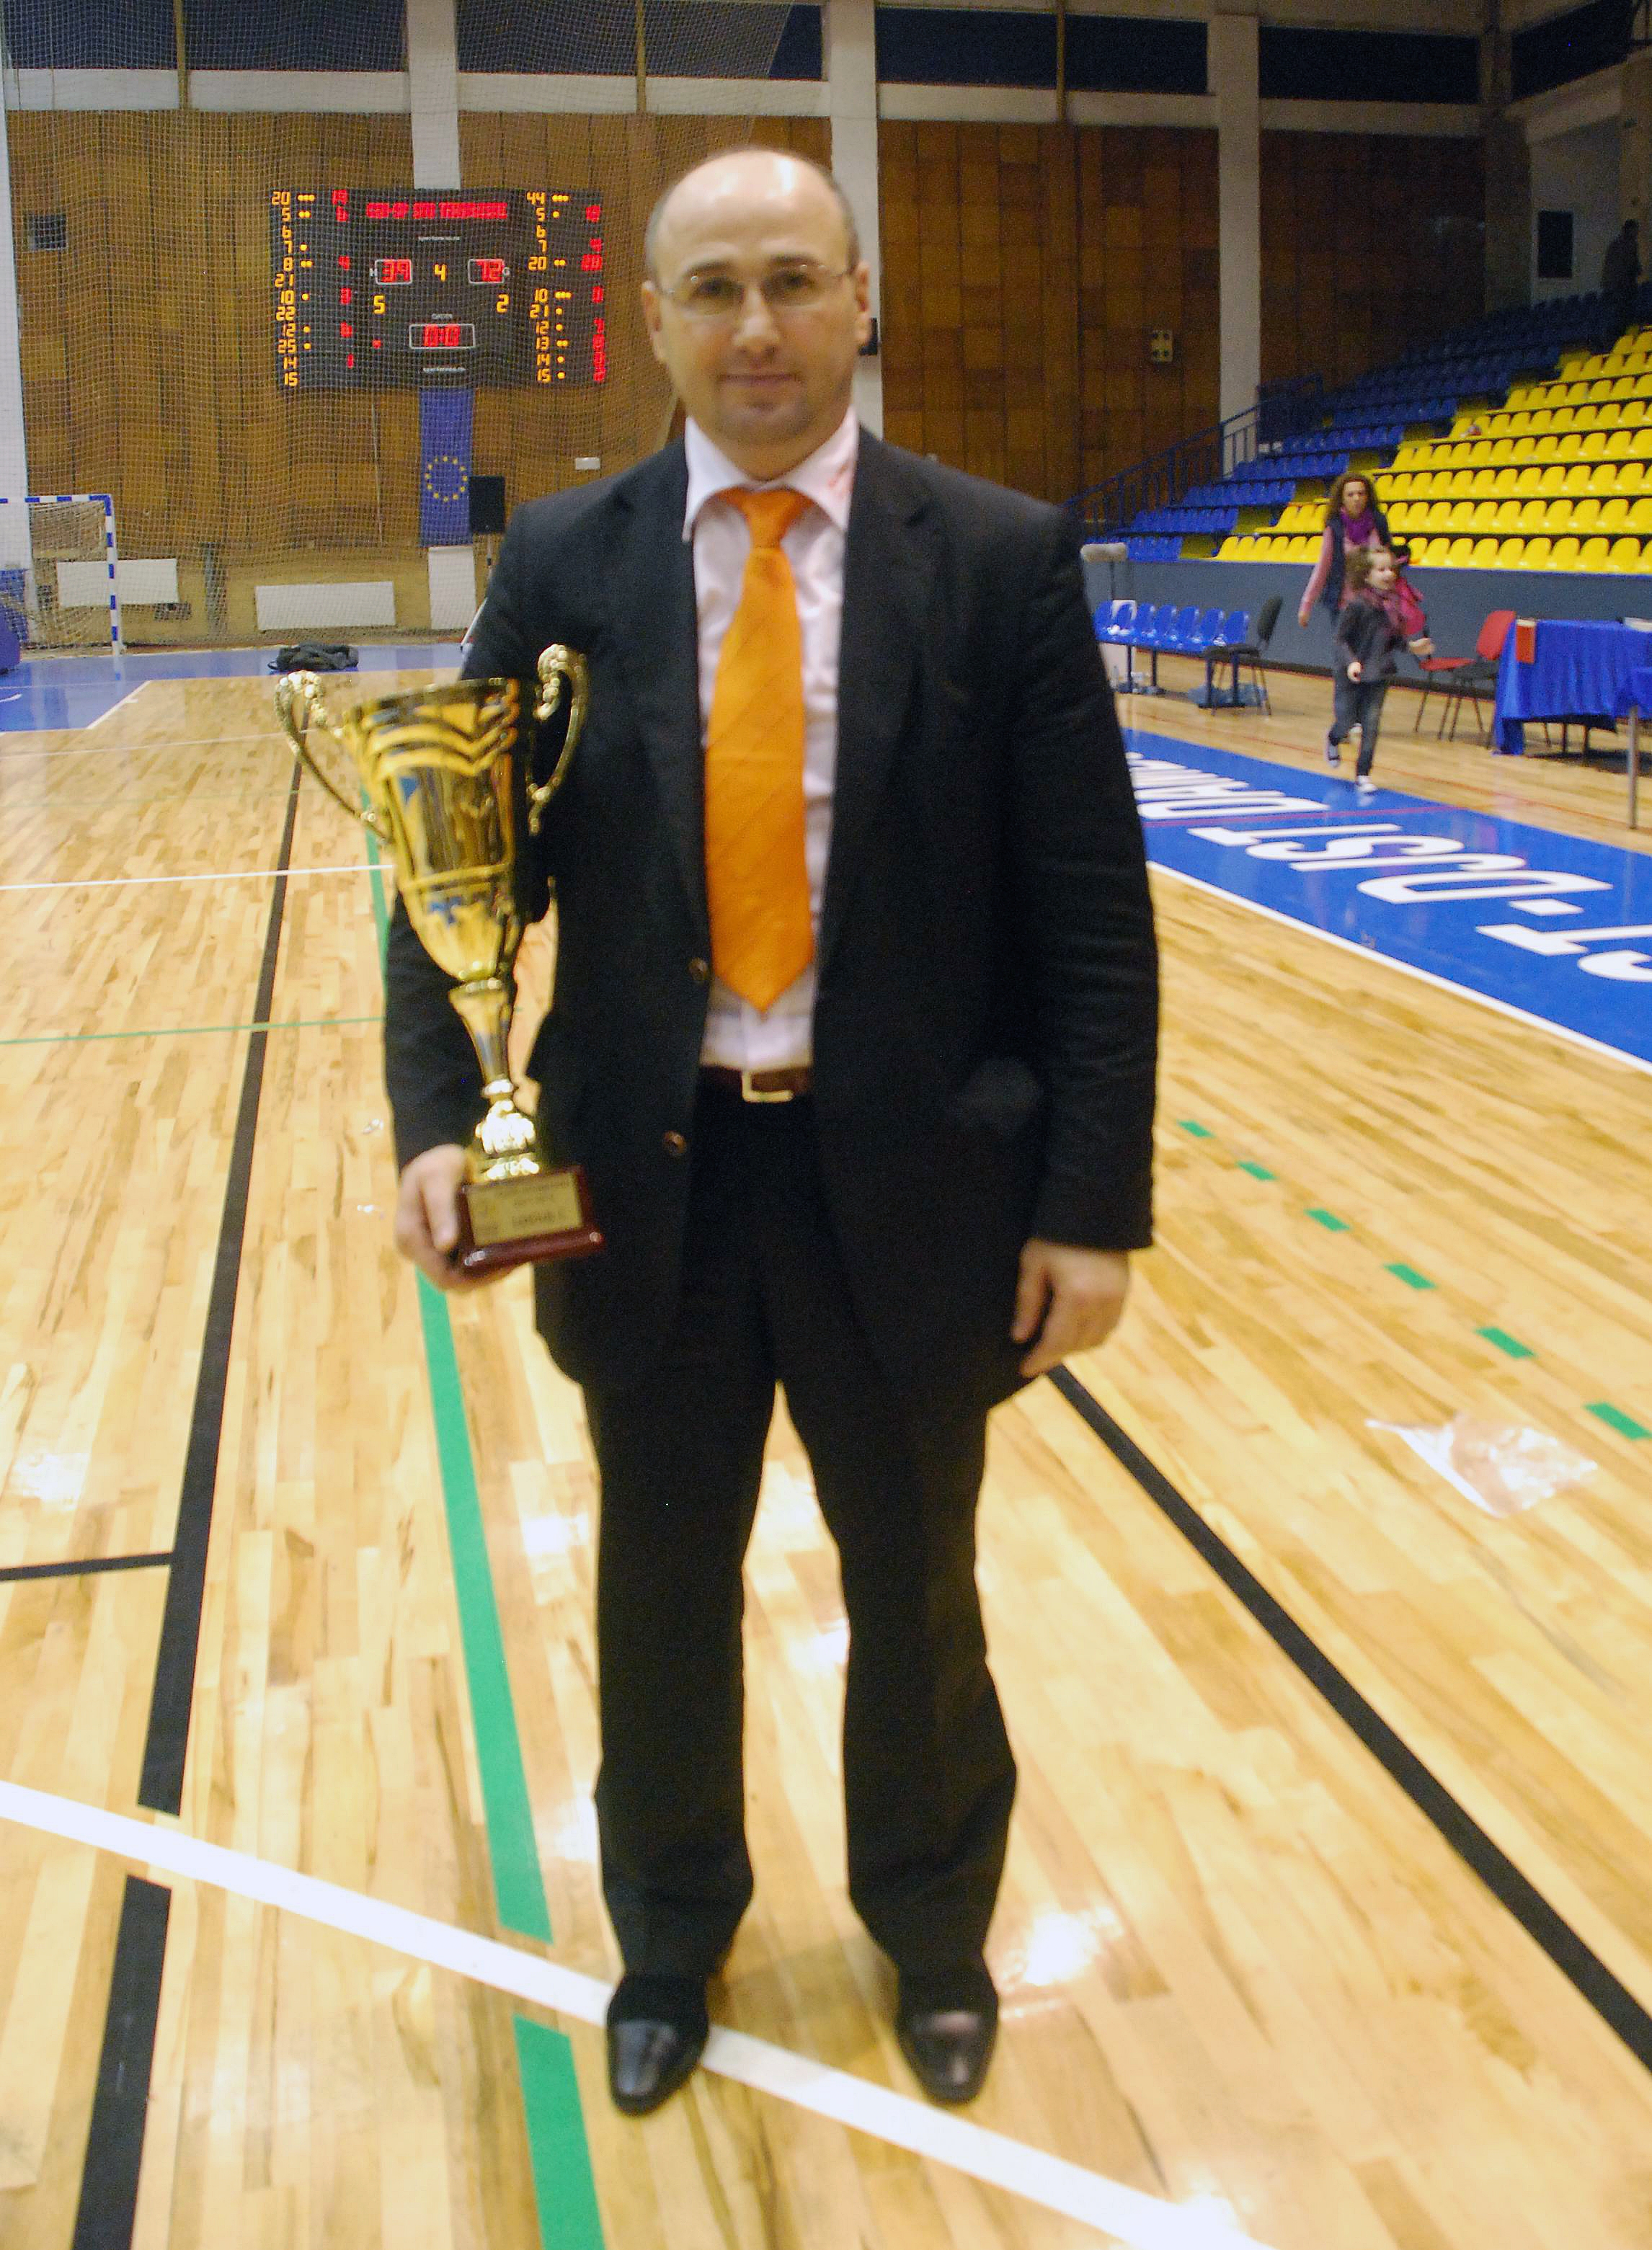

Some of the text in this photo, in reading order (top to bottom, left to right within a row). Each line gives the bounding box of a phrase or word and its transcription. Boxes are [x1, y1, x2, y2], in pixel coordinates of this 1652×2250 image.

[272, 191, 290, 204] 20
[527, 192, 546, 205] 44
[281, 208, 291, 221] 5
[536, 208, 546, 222] 5
[536, 225, 546, 239] 6
[283, 241, 293, 254] 7
[538, 240, 546, 253] 7
[283, 257, 293, 272] 8
[381, 259, 411, 283] 39
[476, 259, 504, 283] 72
[528, 257, 547, 271] 20
[435, 264, 445, 281] 4
[275, 274, 294, 288] 21
[280, 290, 294, 304] 10
[535, 288, 549, 303] 10
[373, 295, 385, 314] 5
[496, 294, 509, 313] 2
[276, 306, 296, 321] 22
[530, 304, 549, 319] 21
[283, 322, 296, 337] 12
[536, 321, 549, 334] 12
[277, 338, 296, 353] 25
[536, 337, 549, 351] 13
[284, 357, 297, 370] 14
[537, 353, 551, 366] 14
[285, 371, 298, 386] 15
[538, 368, 551, 383] 15
